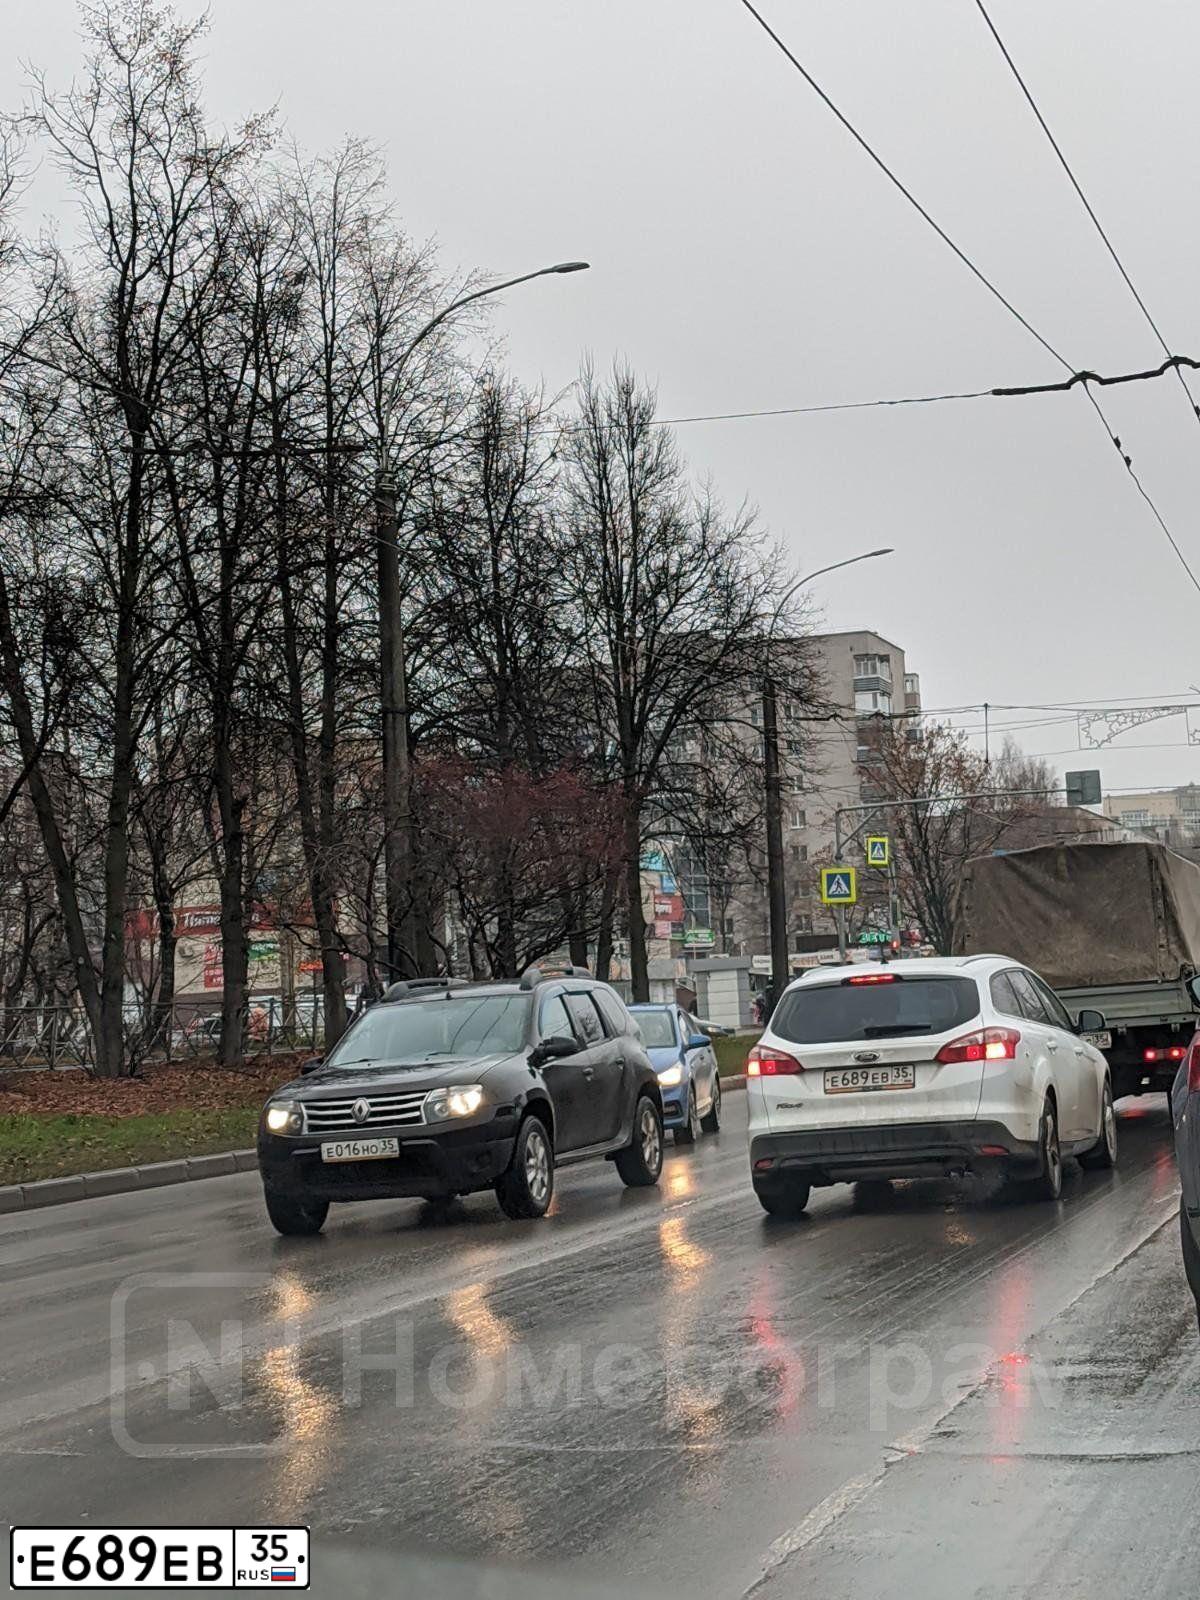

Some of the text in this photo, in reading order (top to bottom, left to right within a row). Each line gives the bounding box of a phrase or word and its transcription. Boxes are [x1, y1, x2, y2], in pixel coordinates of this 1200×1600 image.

[830, 1066, 909, 1087] Е689ЕВ 35
[326, 1139, 395, 1158] Е016НО 35
